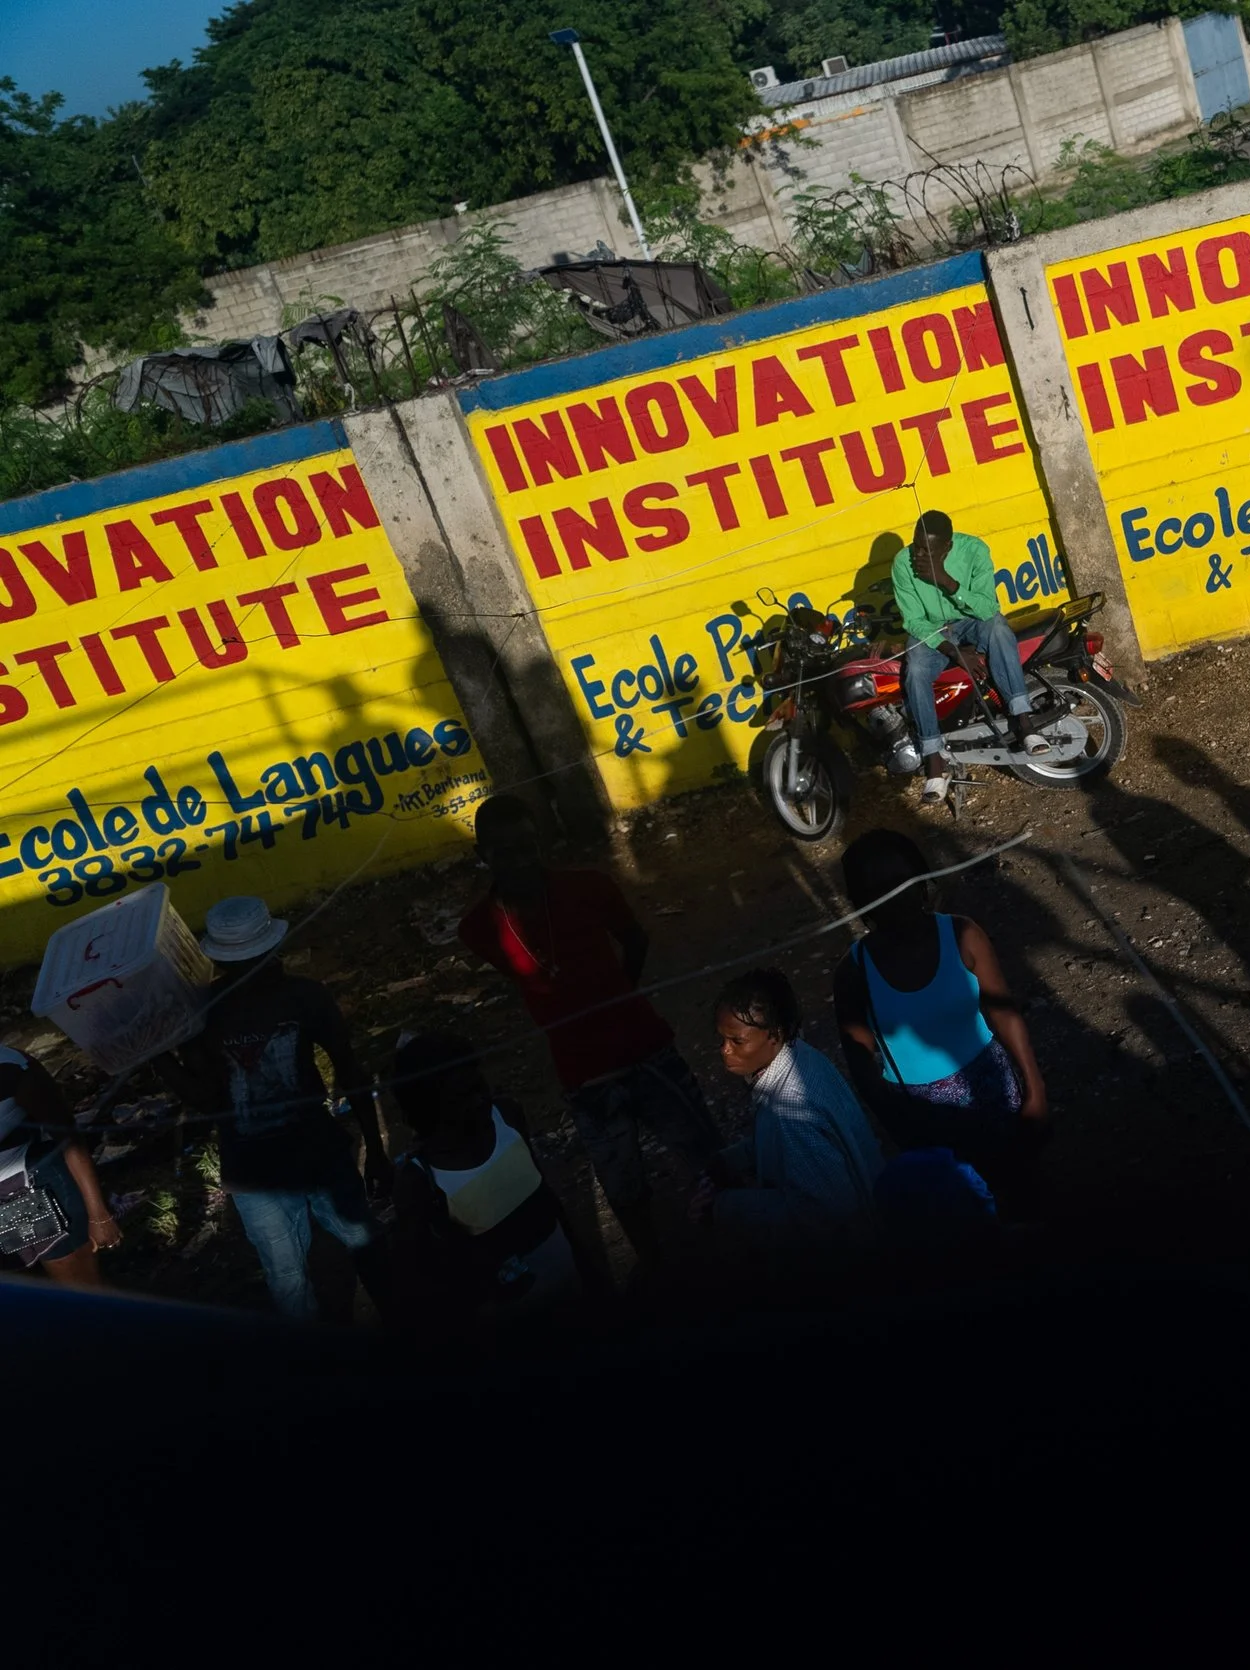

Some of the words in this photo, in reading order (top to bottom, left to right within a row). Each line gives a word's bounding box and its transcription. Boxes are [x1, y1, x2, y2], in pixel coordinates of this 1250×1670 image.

[484, 300, 1008, 494] INNOVATION
[518, 392, 1025, 579] INSTITUTE
[1205, 553, 1234, 594] &
[570, 634, 699, 719] Ecole
[141, 765, 207, 836] de
[207, 718, 472, 815] Langues
[614, 714, 651, 757] &
